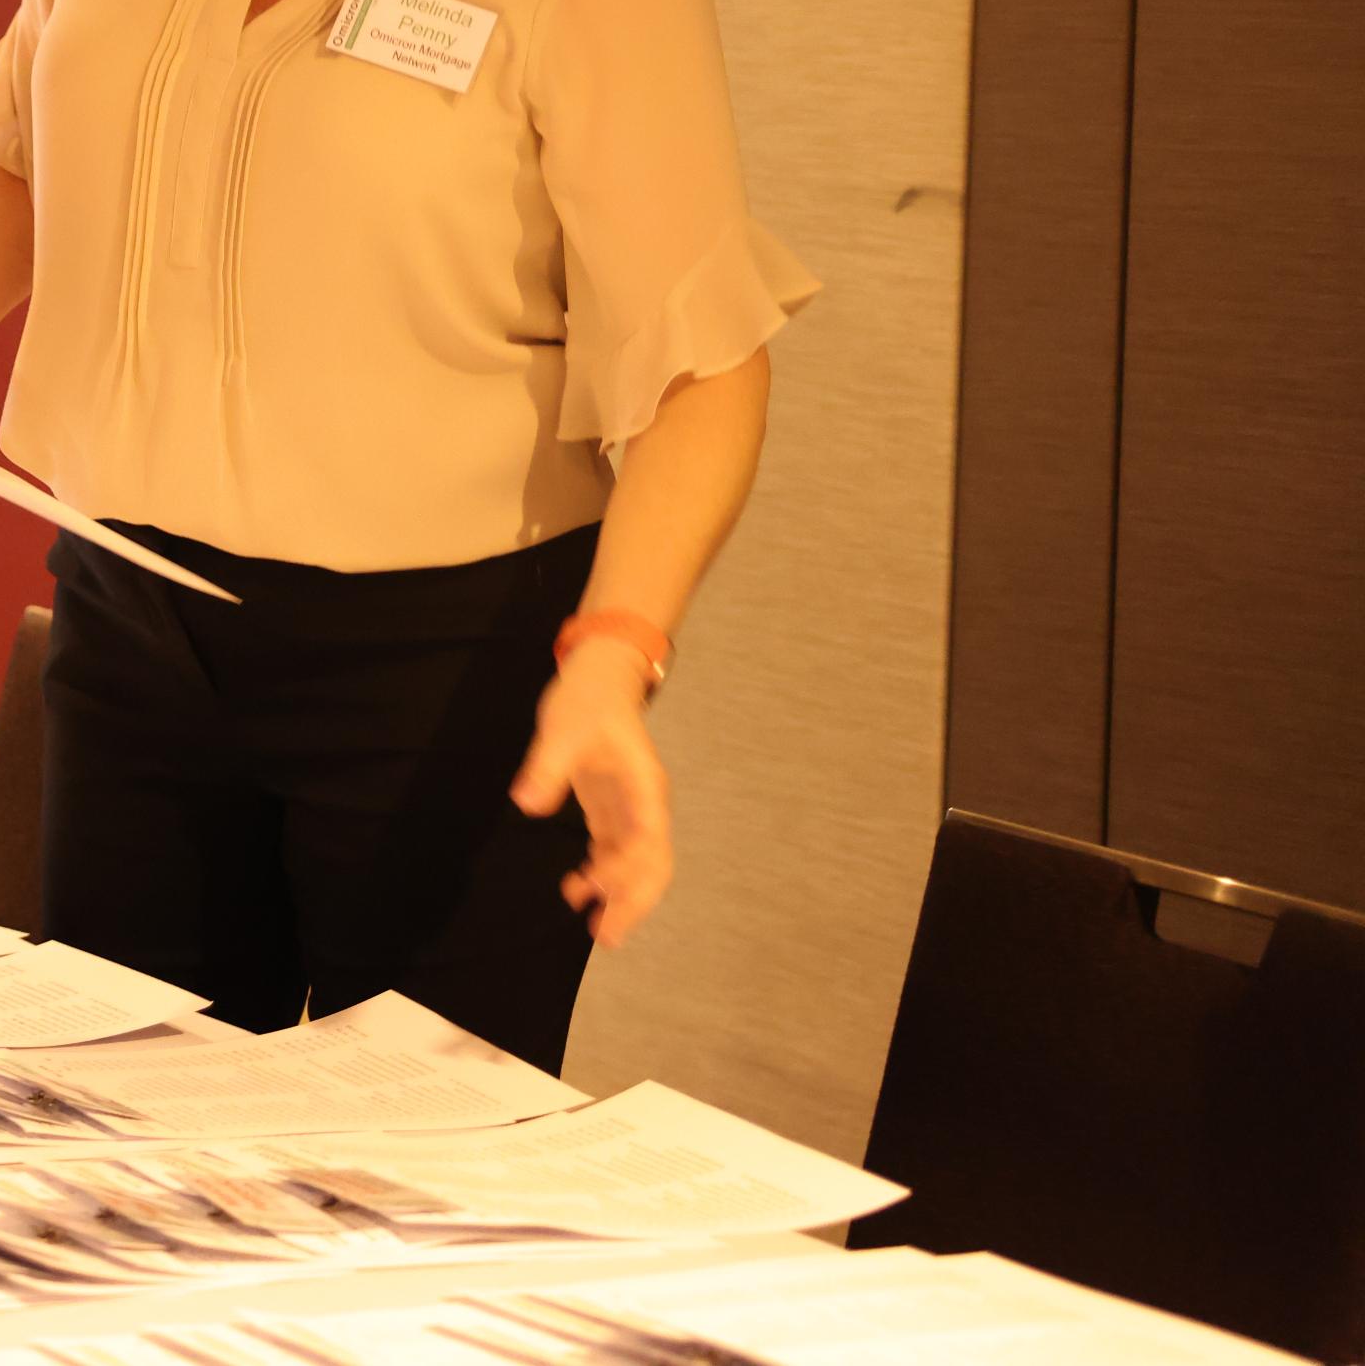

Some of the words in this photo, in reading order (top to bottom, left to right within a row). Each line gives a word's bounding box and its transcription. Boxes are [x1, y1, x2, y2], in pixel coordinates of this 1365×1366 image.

[370, 28, 416, 52] Omicron
[418, 44, 471, 71] Mortgage
[398, 14, 458, 50] Penny
[392, 50, 437, 74] Network
